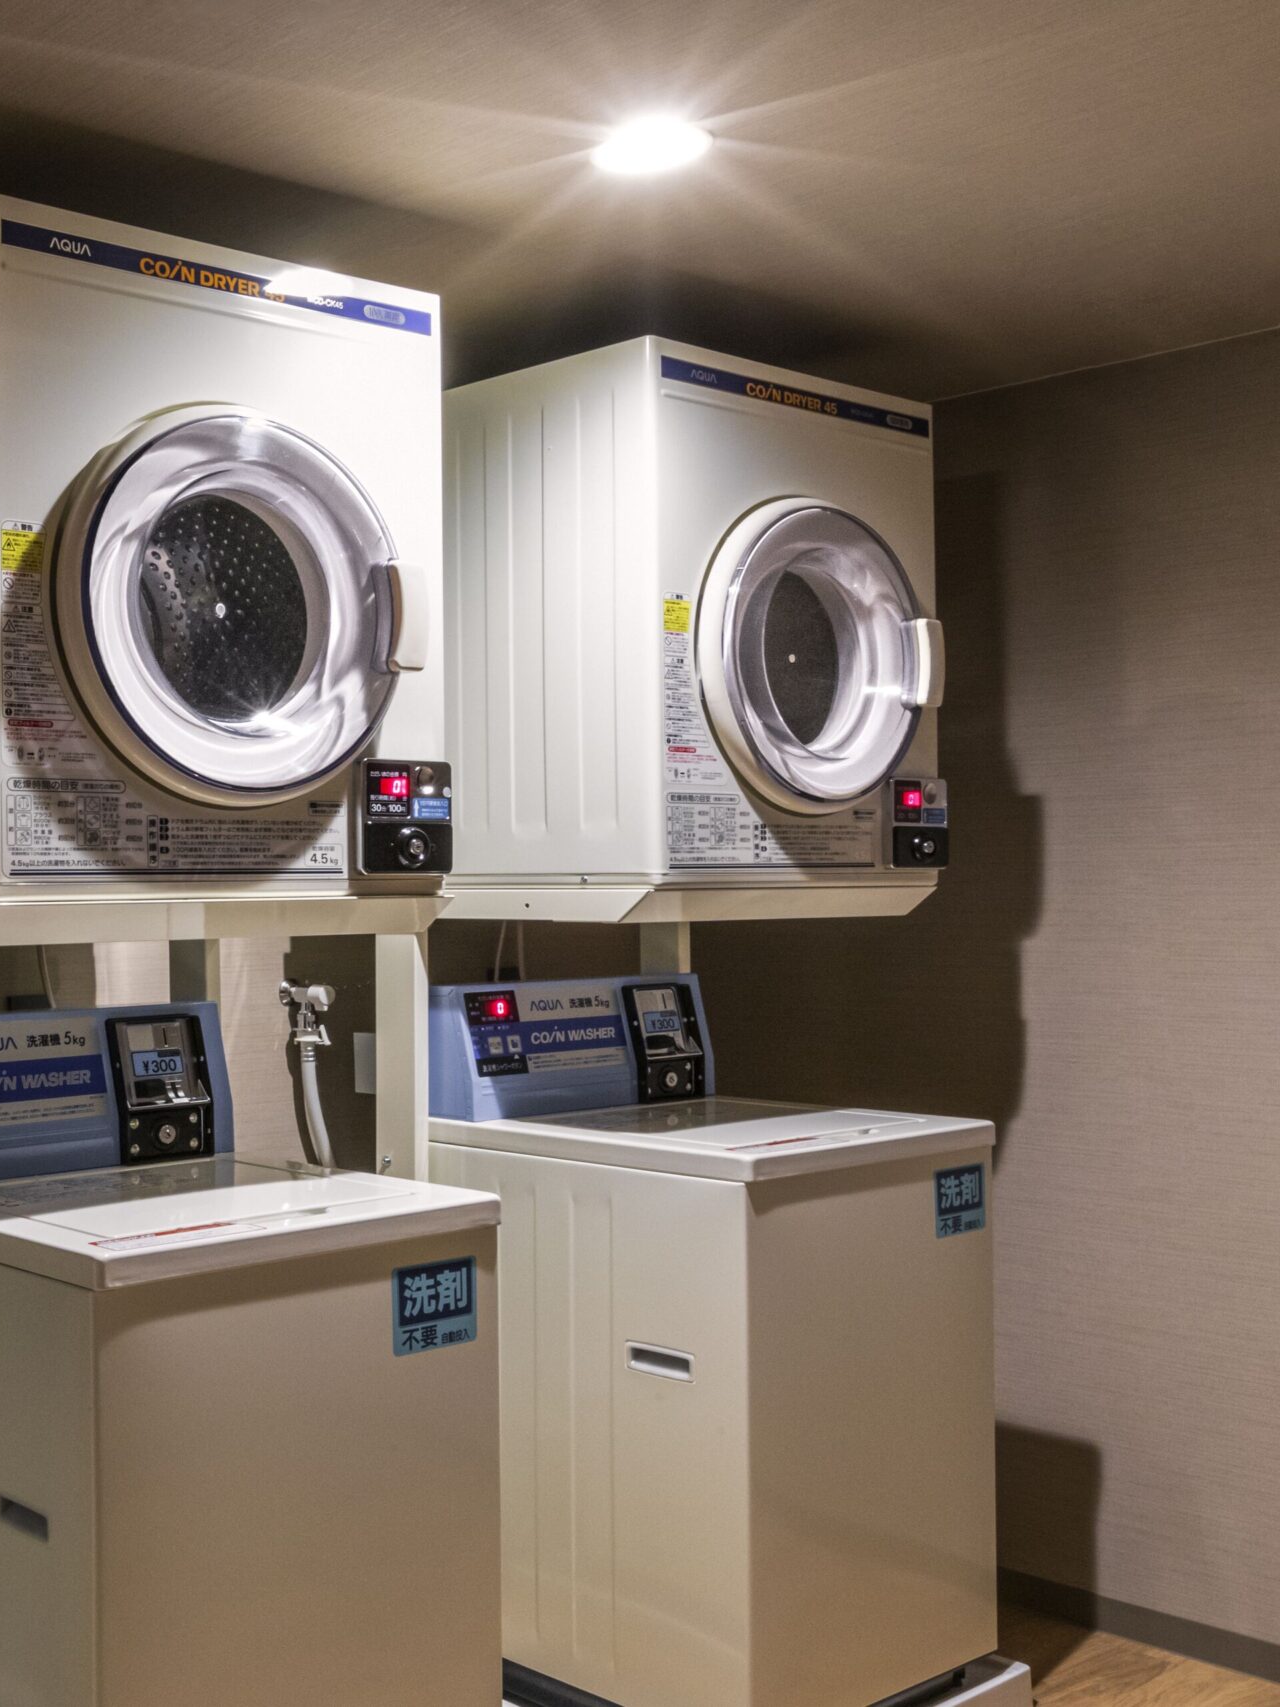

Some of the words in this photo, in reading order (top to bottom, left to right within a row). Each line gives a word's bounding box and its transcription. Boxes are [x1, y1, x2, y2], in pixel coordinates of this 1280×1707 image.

[50, 237, 91, 257] AQUA
[200, 271, 260, 297] DRYER
[690, 368, 717, 384] AQUA
[784, 391, 821, 411] DRYER
[823, 401, 838, 415] 45
[13, 780, 79, 791] 乾燥時間の目安
[310, 853, 328, 864] 4.5
[530, 999, 563, 1011] AQUA
[594, 995, 610, 1008] 5kg
[26, 1033, 61, 1048] 洗濯機
[63, 1031, 86, 1047] 5kg
[568, 1027, 616, 1042] WASHER
[142, 1058, 177, 1074] ¥300
[22, 1069, 91, 1090] WASHER
[940, 1171, 979, 1209] 洗剤
[403, 1267, 468, 1318] 洗剤
[402, 1324, 438, 1351] 不要
